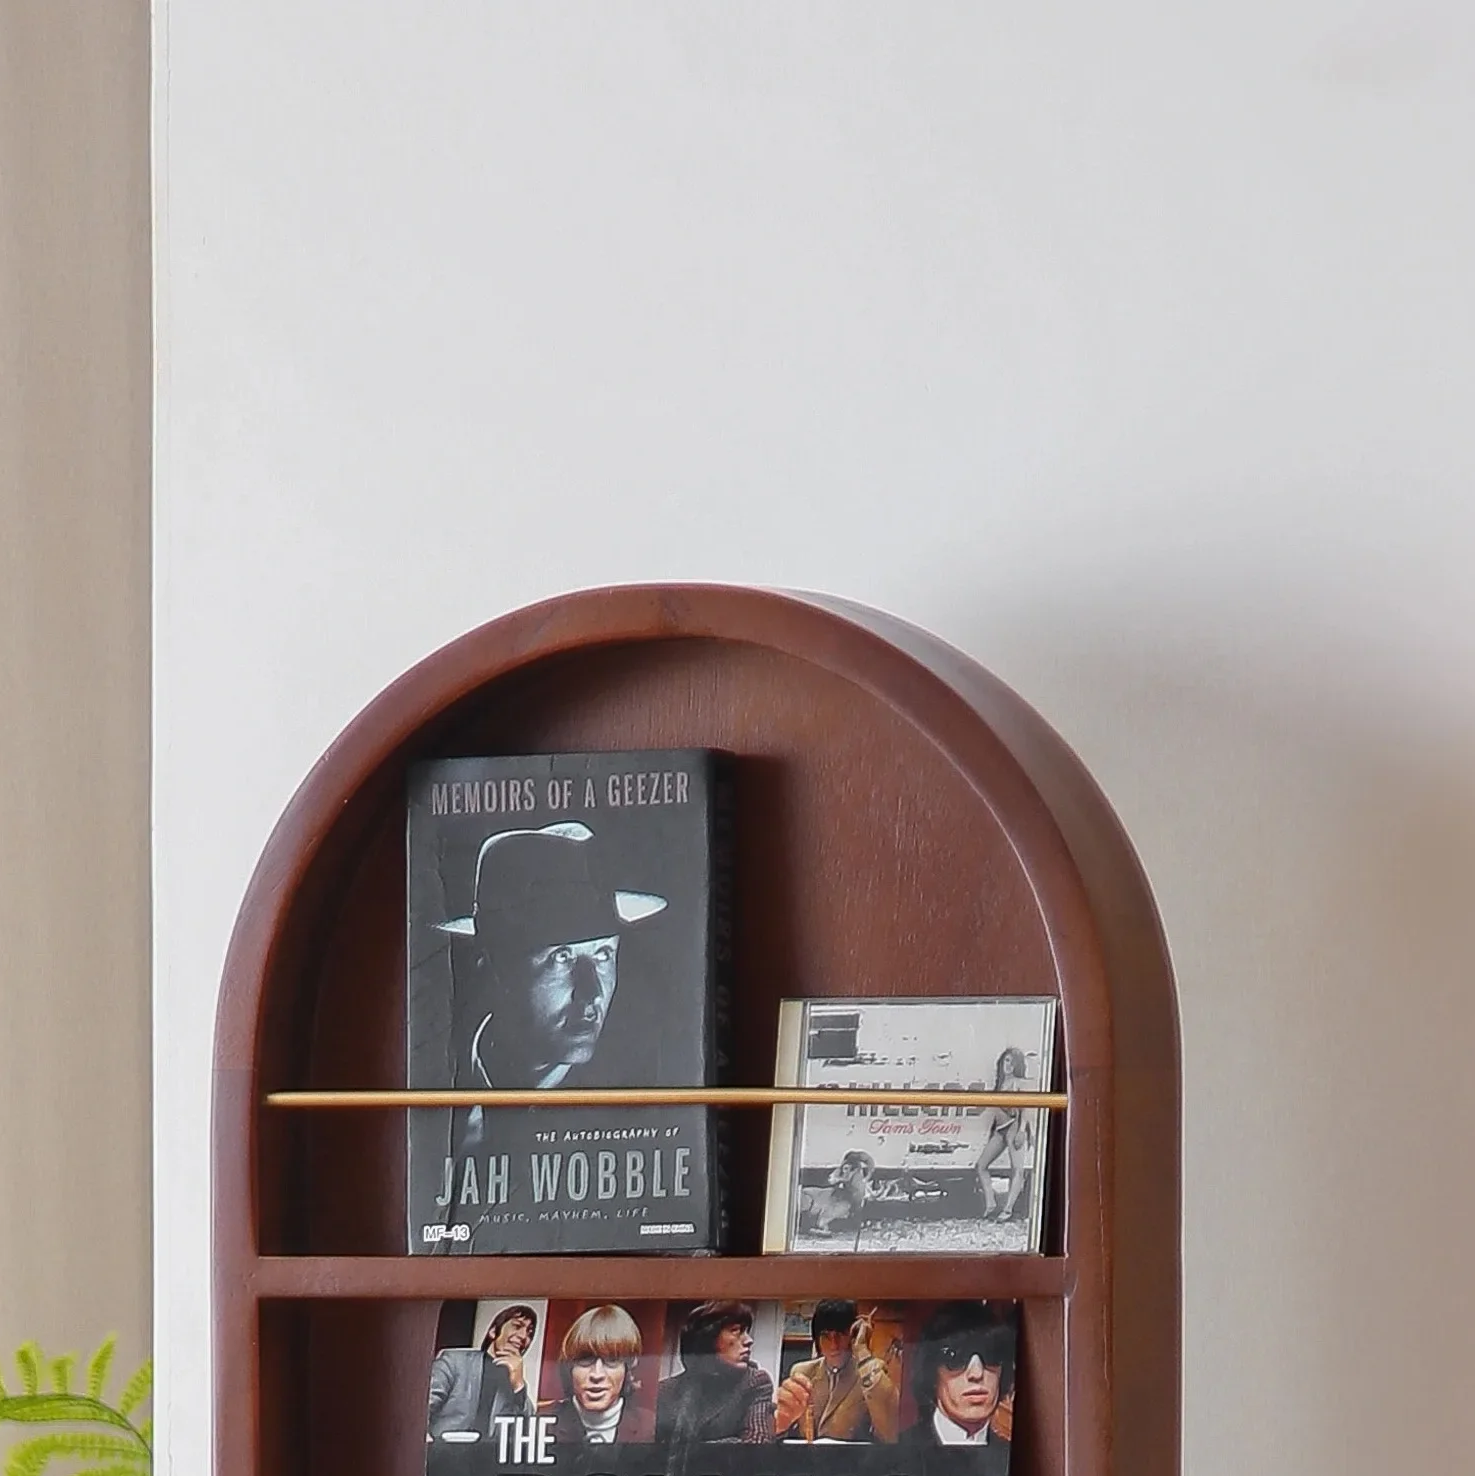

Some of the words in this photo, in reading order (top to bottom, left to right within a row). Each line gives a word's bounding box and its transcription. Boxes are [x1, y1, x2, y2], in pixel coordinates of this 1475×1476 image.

[431, 779, 536, 815] MEMOIRS
[548, 779, 573, 809] OF
[584, 778, 596, 807] A
[607, 771, 690, 807] GEEZER
[536, 1131, 556, 1143] THE
[564, 1128, 658, 1141] AUTOBIOGRAPHY
[665, 1127, 680, 1138] OF
[918, 1119, 962, 1135] Town
[436, 1154, 510, 1206] JAH
[531, 1147, 691, 1203] WOBBLE
[616, 1207, 649, 1219] LIFE
[424, 1224, 470, 1243] MF-13
[495, 1416, 556, 1465] THE
